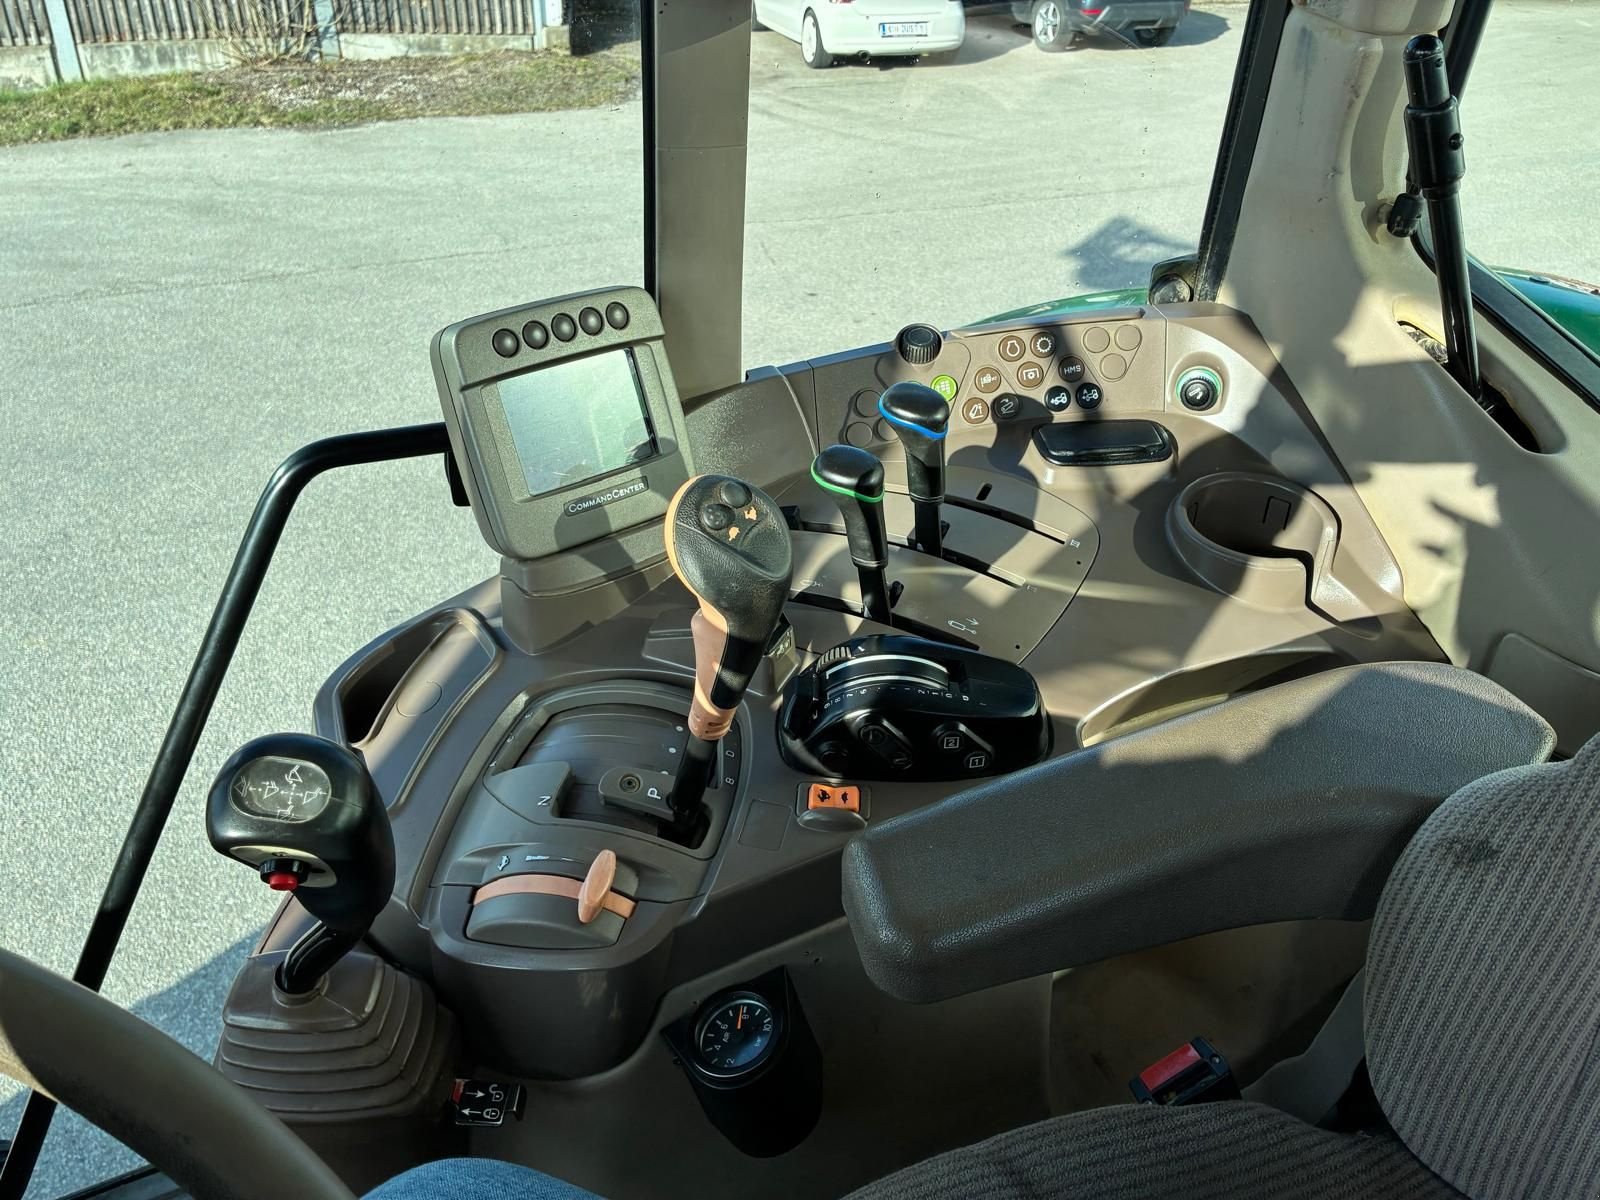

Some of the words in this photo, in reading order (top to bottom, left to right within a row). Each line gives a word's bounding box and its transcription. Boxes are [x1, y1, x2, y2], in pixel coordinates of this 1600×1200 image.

[1063, 364, 1082, 375] HMS
[647, 787, 662, 800] P
[537, 795, 553, 807] N
[762, 1023, 772, 1032] 10
